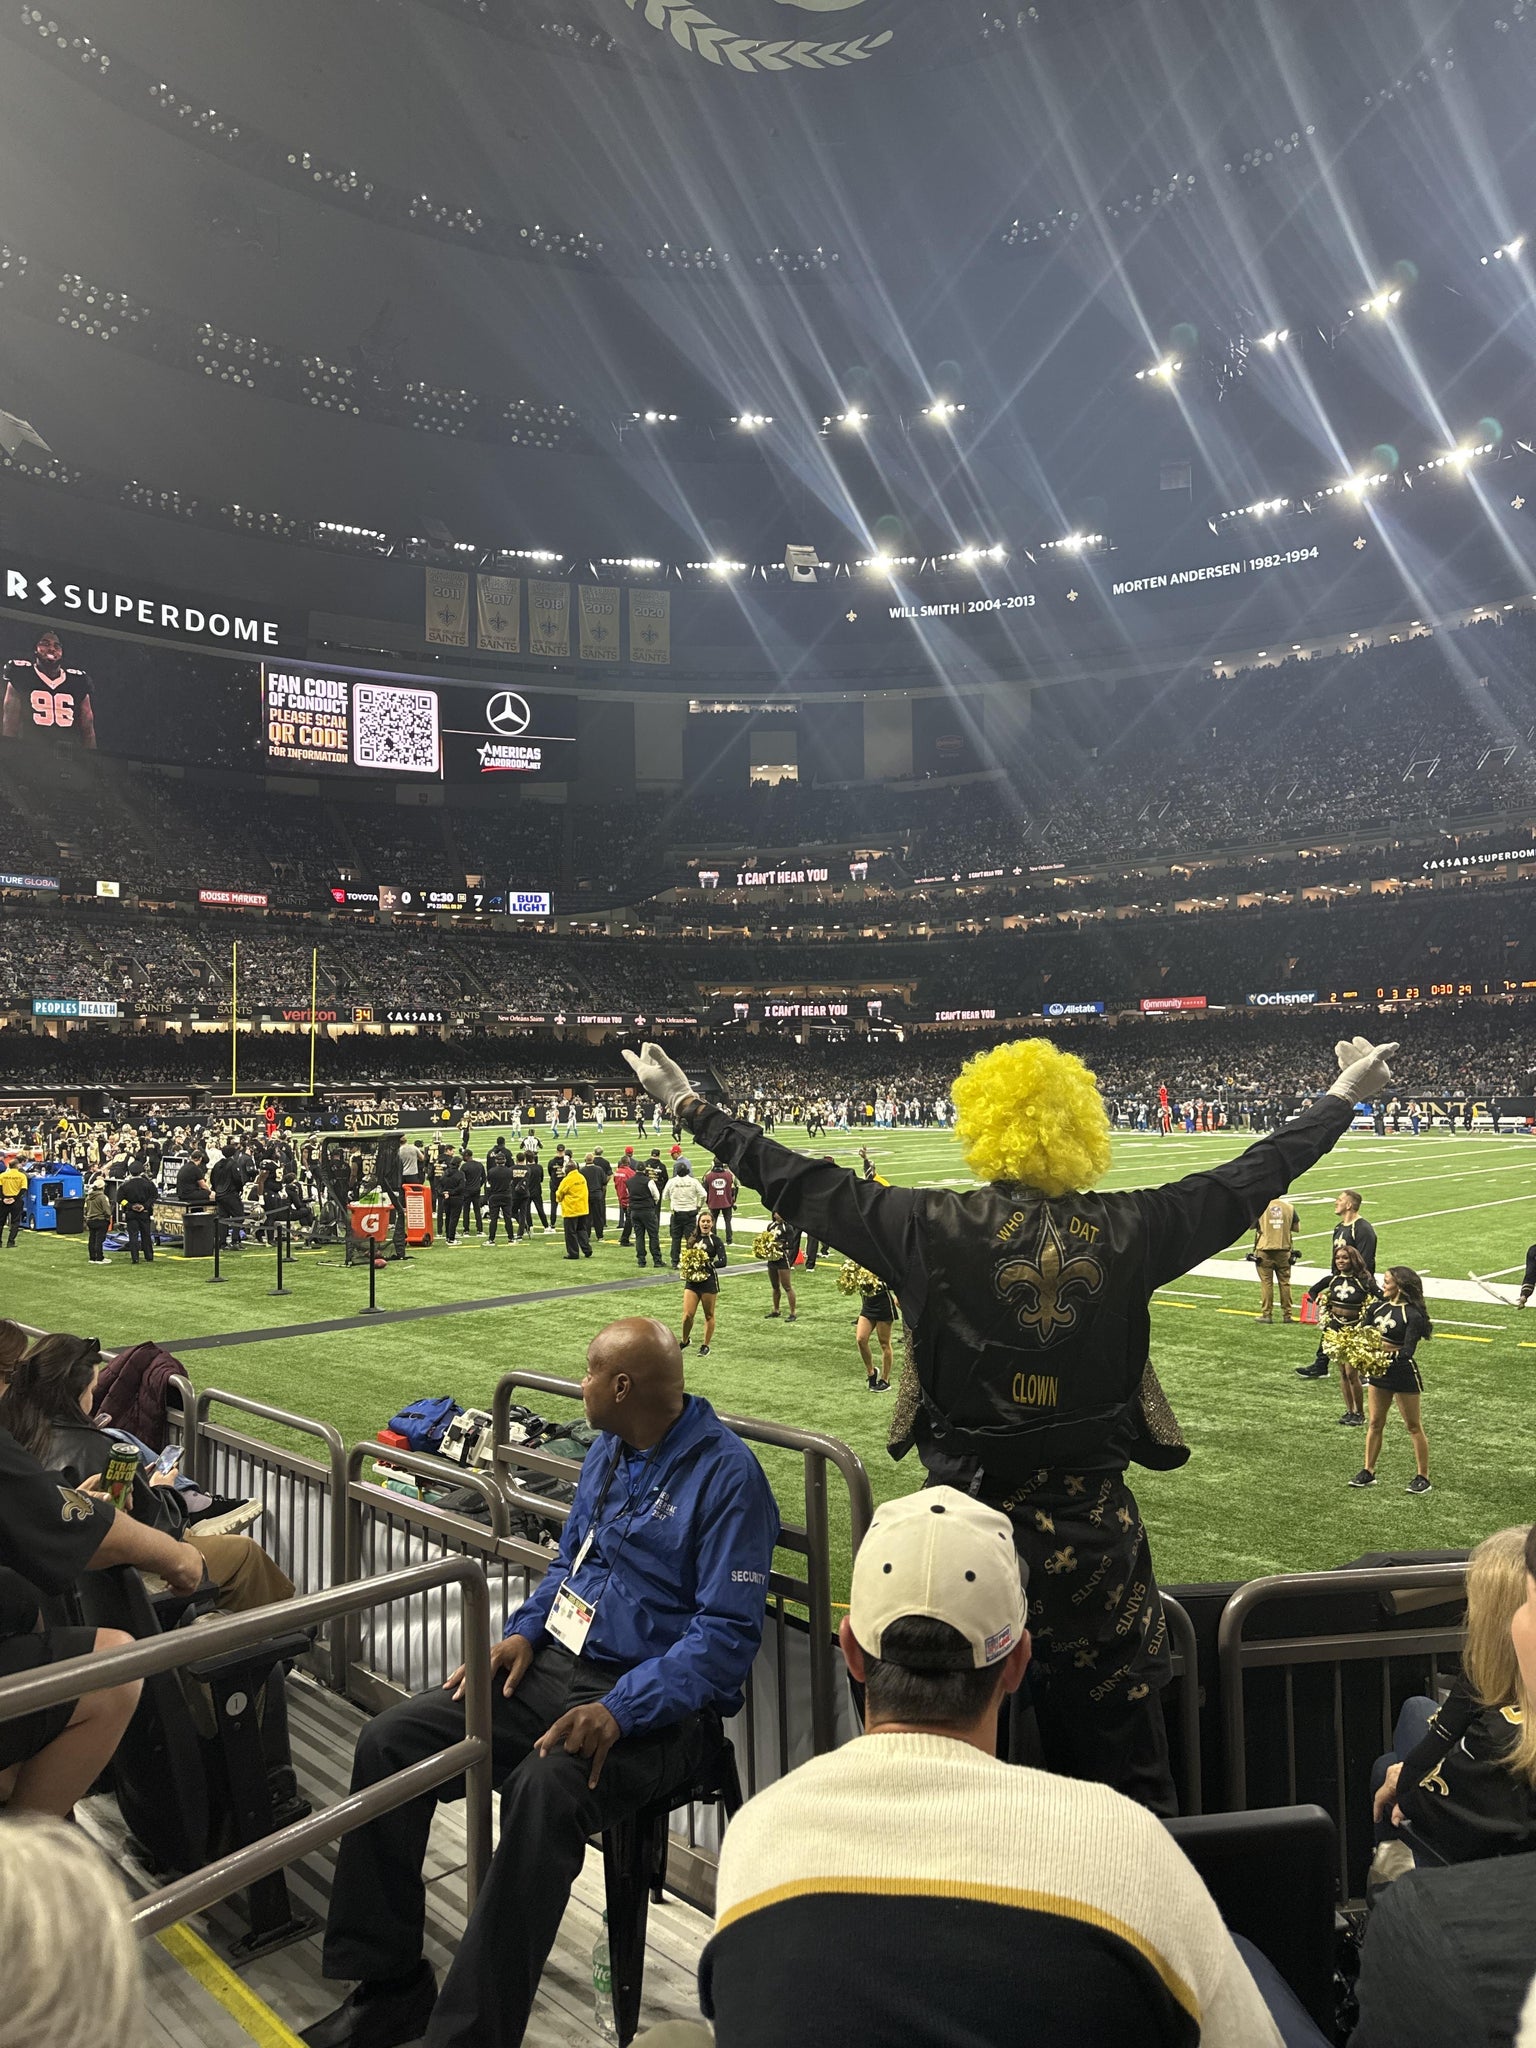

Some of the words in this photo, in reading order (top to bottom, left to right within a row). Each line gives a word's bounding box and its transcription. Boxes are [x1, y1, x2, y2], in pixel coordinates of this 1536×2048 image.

[1112, 574, 1167, 595] MORTEN
[1170, 562, 1240, 585] ANDERSEN
[1250, 546, 1319, 570] 1982-1994
[434, 587, 460, 600] 2011
[485, 594, 512, 606] 2017
[535, 598, 563, 610] 2018
[585, 603, 614, 614] 2019
[634, 606, 664, 618] 2020
[889, 605, 918, 618] WILL
[920, 603, 959, 617] SMITH
[968, 595, 1036, 613] 2004-2013
[64, 584, 279, 645] SUPERDOME
[428, 633, 466, 645] SAINTS
[480, 640, 517, 651] SAINTS
[532, 644, 568, 656] SAINTS
[582, 649, 617, 660] SAINTS
[632, 652, 668, 664] SAINTS
[268, 673, 300, 694] FAN
[304, 678, 348, 700] CODE
[30, 690, 74, 727] 96
[269, 692, 285, 707] OF
[288, 694, 348, 714] CONDUCT
[270, 708, 313, 725] PLEASE
[315, 714, 346, 729] SCAN
[268, 722, 294, 746] QR
[300, 726, 348, 750] CODE
[269, 746, 286, 756] FOR
[287, 748, 348, 763] INFORMATION
[476, 741, 541, 762] AMERICAS
[1423, 856, 1476, 870] CAESARS
[1478, 849, 1536, 863] SUPERDOM
[0, 875, 23, 885] TURE
[24, 878, 59, 888] GLOBAL
[737, 874, 744, 885] I
[745, 871, 775, 885] CAN'T
[778, 870, 804, 884] HEAR
[806, 869, 828, 882] YOU
[200, 891, 230, 902] ROUSES
[231, 894, 266, 904] MARKETS
[276, 897, 308, 906] SAINTS
[347, 893, 378, 901] TOYOTA
[402, 891, 411, 904] 0
[430, 892, 454, 902] 0:30
[473, 895, 483, 906] 7
[512, 903, 546, 912] LIGHT
[1377, 988, 1384, 998] 0
[1392, 990, 1398, 999] 3
[1406, 988, 1419, 998] 23
[1431, 984, 1452, 995] 0:30
[1458, 985, 1472, 995] 29
[1257, 992, 1314, 1005] Ochsner
[1330, 993, 1336, 1002] 2
[35, 1002, 77, 1014] PEOPLES
[81, 1002, 115, 1015] HEALTH
[134, 1003, 172, 1012] SAINTS
[765, 1006, 771, 1016] I
[772, 1006, 799, 1016] CAN'T
[802, 1006, 826, 1016] HEAR
[828, 1004, 848, 1016] YOU
[1064, 1004, 1096, 1014] Allstate
[1144, 998, 1182, 1010] Community
[282, 1008, 337, 1021] verizon
[355, 1009, 371, 1021] 34
[386, 1011, 442, 1022] CAESARS
[450, 1011, 480, 1019] SAINTS
[936, 1012, 940, 1021] I
[940, 1011, 961, 1021] CAN'T
[962, 1010, 979, 1020] HEAR
[980, 1010, 995, 1019] YOU
[361, 1214, 379, 1233] G
[996, 1211, 1024, 1241] WHO
[1069, 1217, 1100, 1244] DAT
[1012, 1372, 1058, 1407] CLOWN
[731, 1570, 766, 1585] SECURITY
[1071, 1554, 1112, 1606] SAINTS
[1116, 1582, 1146, 1636] SAINTS
[593, 1964, 610, 1981] ite
